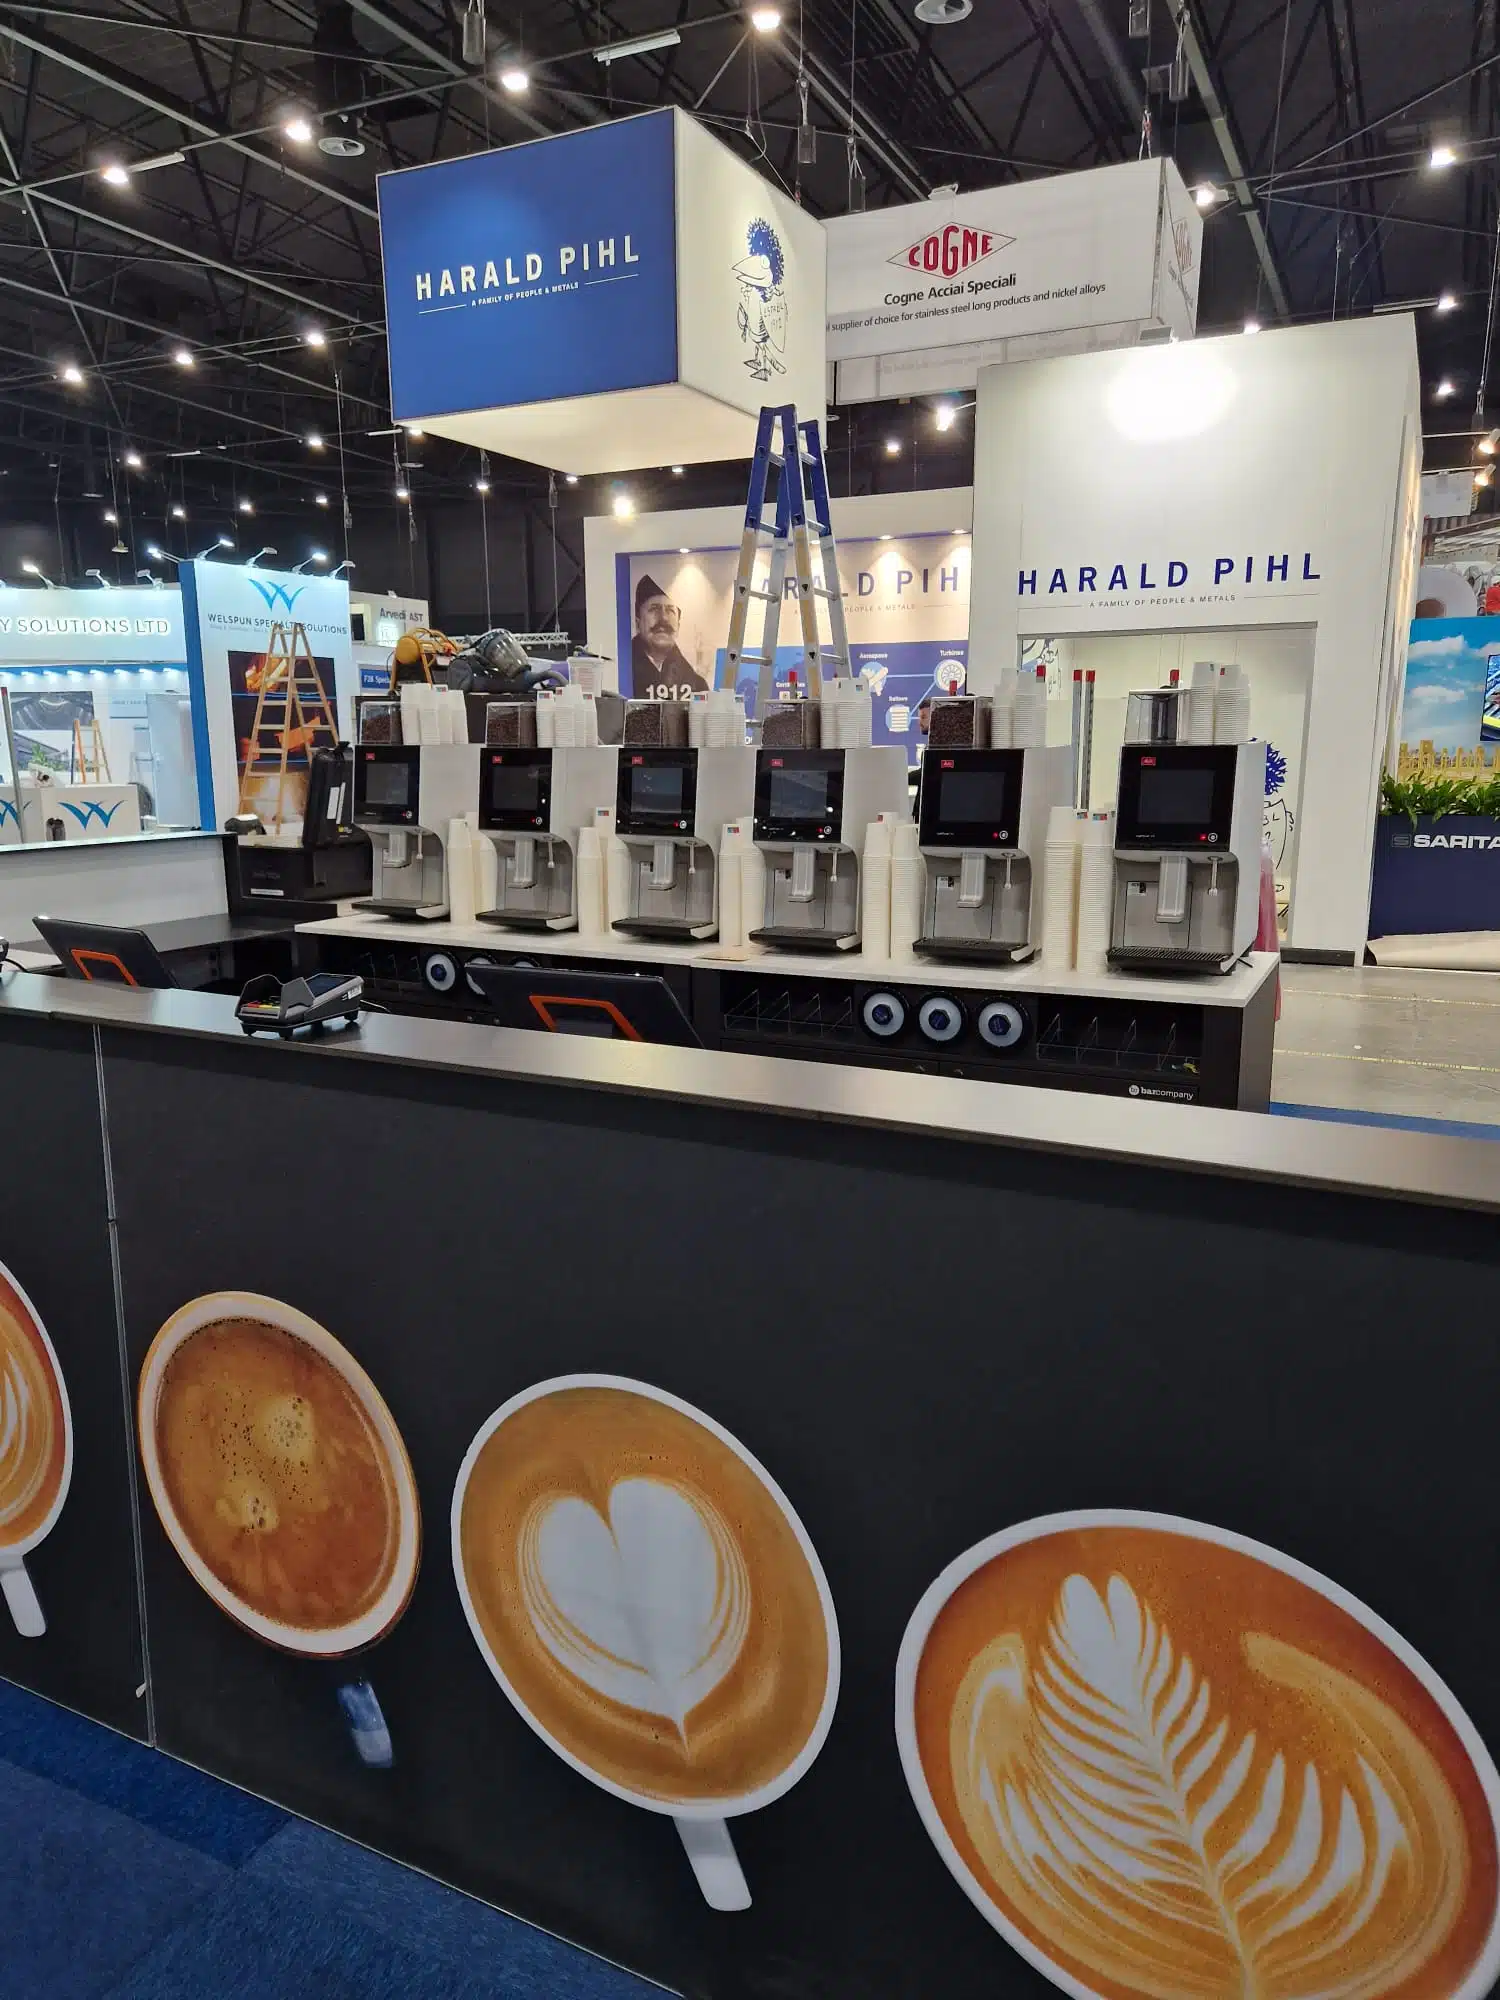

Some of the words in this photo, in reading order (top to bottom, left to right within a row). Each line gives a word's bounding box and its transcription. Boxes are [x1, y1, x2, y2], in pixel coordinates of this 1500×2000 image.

[908, 225, 993, 276] COGNE
[416, 253, 542, 300] HARALD
[560, 235, 639, 275] PIHL
[478, 296, 502, 306] FAMILY
[504, 293, 514, 301] OF
[516, 288, 542, 299] PEOPLE
[552, 281, 579, 293] METALS
[884, 290, 924, 306] Cogne
[928, 282, 964, 299] Acciai
[967, 273, 1016, 296] Speciali
[831, 317, 863, 332] supplier
[864, 315, 874, 327] of
[874, 312, 899, 325] choice
[901, 310, 913, 322] for
[914, 305, 949, 320] stainless
[950, 302, 970, 314] steel
[972, 300, 991, 313] long
[993, 293, 1031, 309] products
[1032, 290, 1050, 302] and
[1051, 286, 1078, 299] nickel
[1079, 281, 1106, 296] alloys
[896, 566, 958, 594] PIH
[1018, 561, 1188, 595] HARALD
[1213, 553, 1321, 585] PIHL
[1099, 600, 1130, 608] FAMILY
[1150, 597, 1185, 605] PEOPLE
[1199, 595, 1236, 603] METALS
[18, 619, 129, 633] SOLUTIONS
[136, 620, 168, 633] LTD
[207, 613, 252, 625] WELSPUN
[302, 622, 348, 635] SOLUTIONS
[380, 607, 407, 619] Arvedi
[409, 612, 423, 622] AST
[645, 684, 692, 702] 1912
[1140, 1086, 1194, 1101] barcompany
